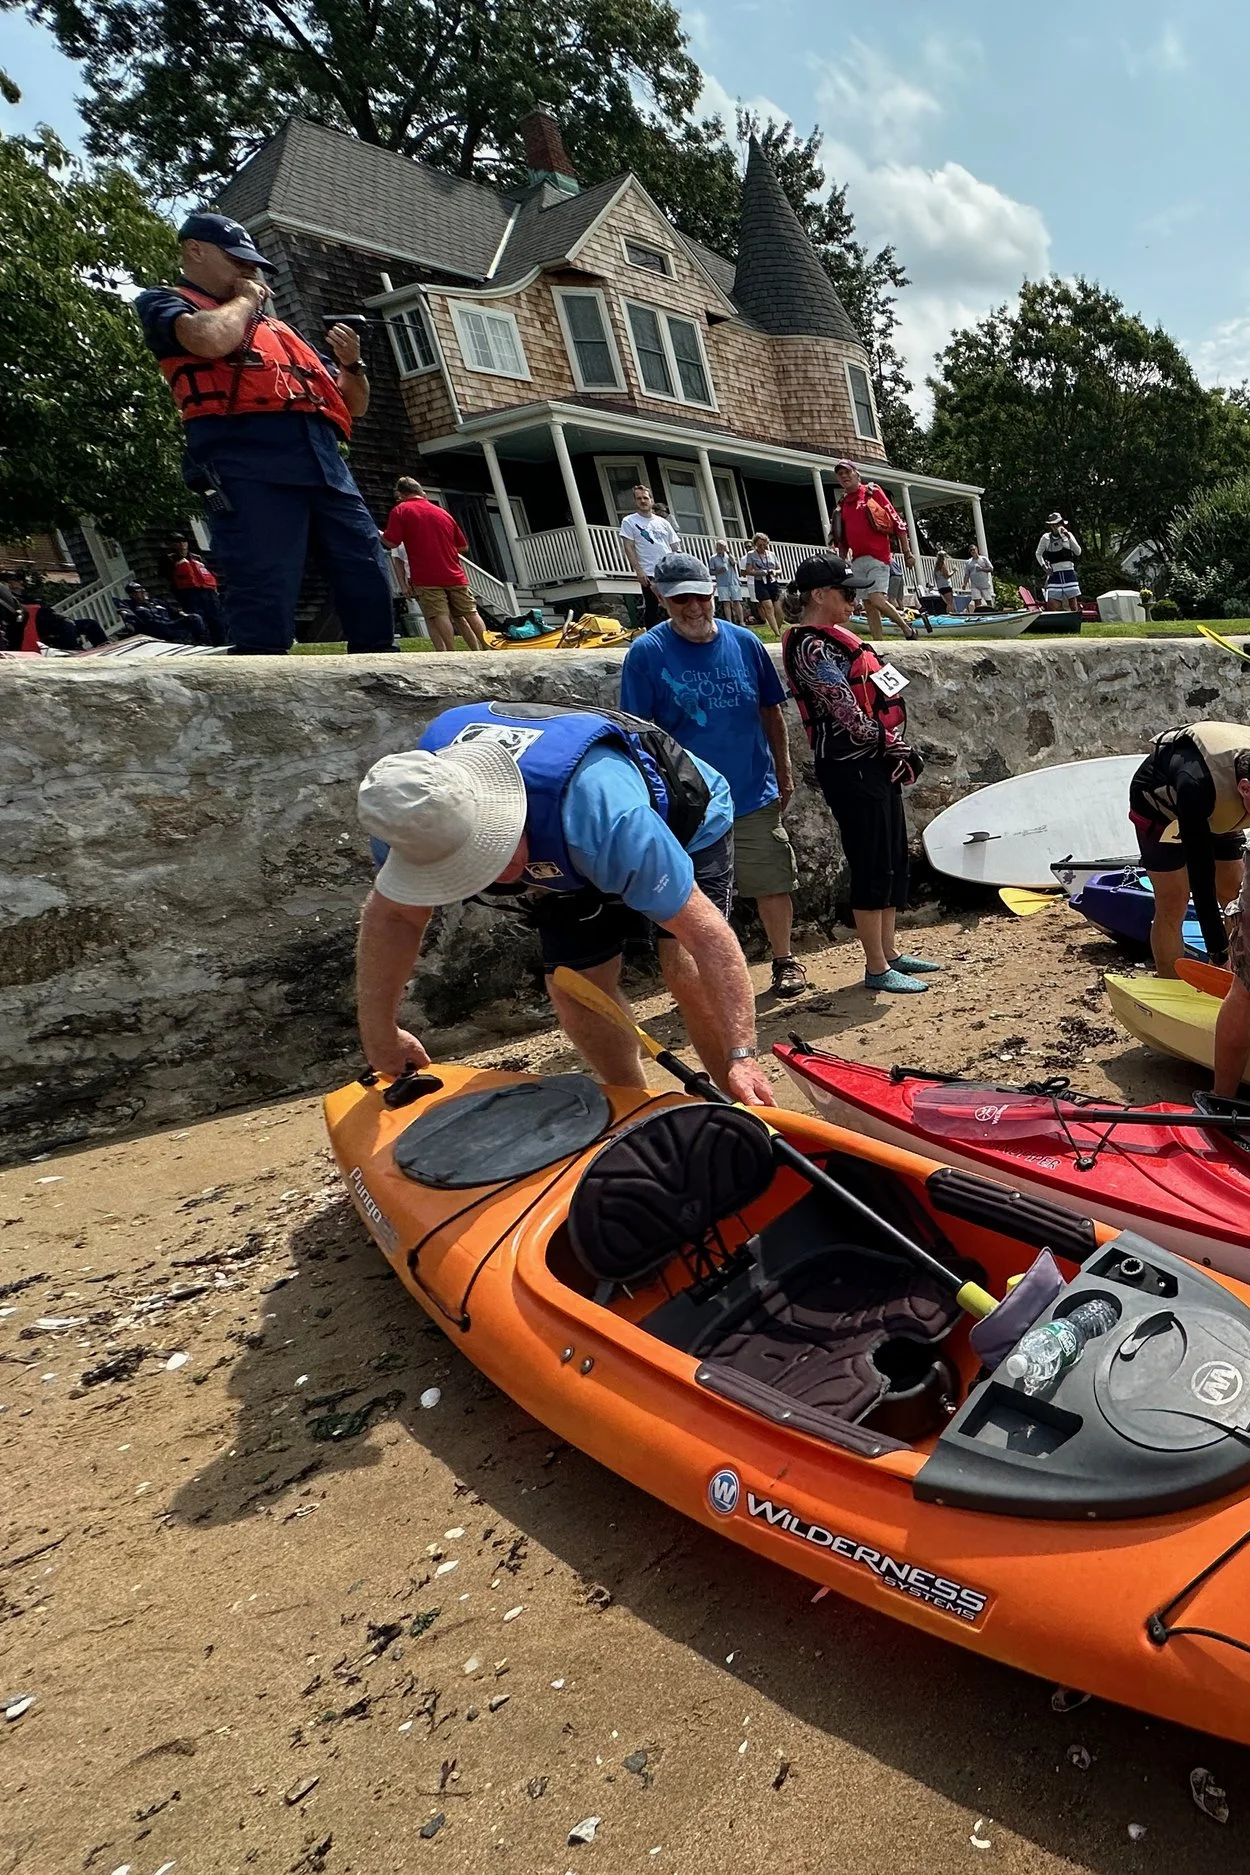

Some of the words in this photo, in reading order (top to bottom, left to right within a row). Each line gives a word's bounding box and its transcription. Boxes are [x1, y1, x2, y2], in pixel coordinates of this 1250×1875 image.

[681, 670, 711, 683] City
[714, 666, 750, 680] Island
[877, 670, 900, 691] 15
[708, 694, 741, 710] Reef
[349, 1166, 382, 1223] Pungo
[713, 1475, 737, 1506] W
[746, 1491, 988, 1613] WILDERNESS
[883, 1575, 976, 1621] SYSTEMS
